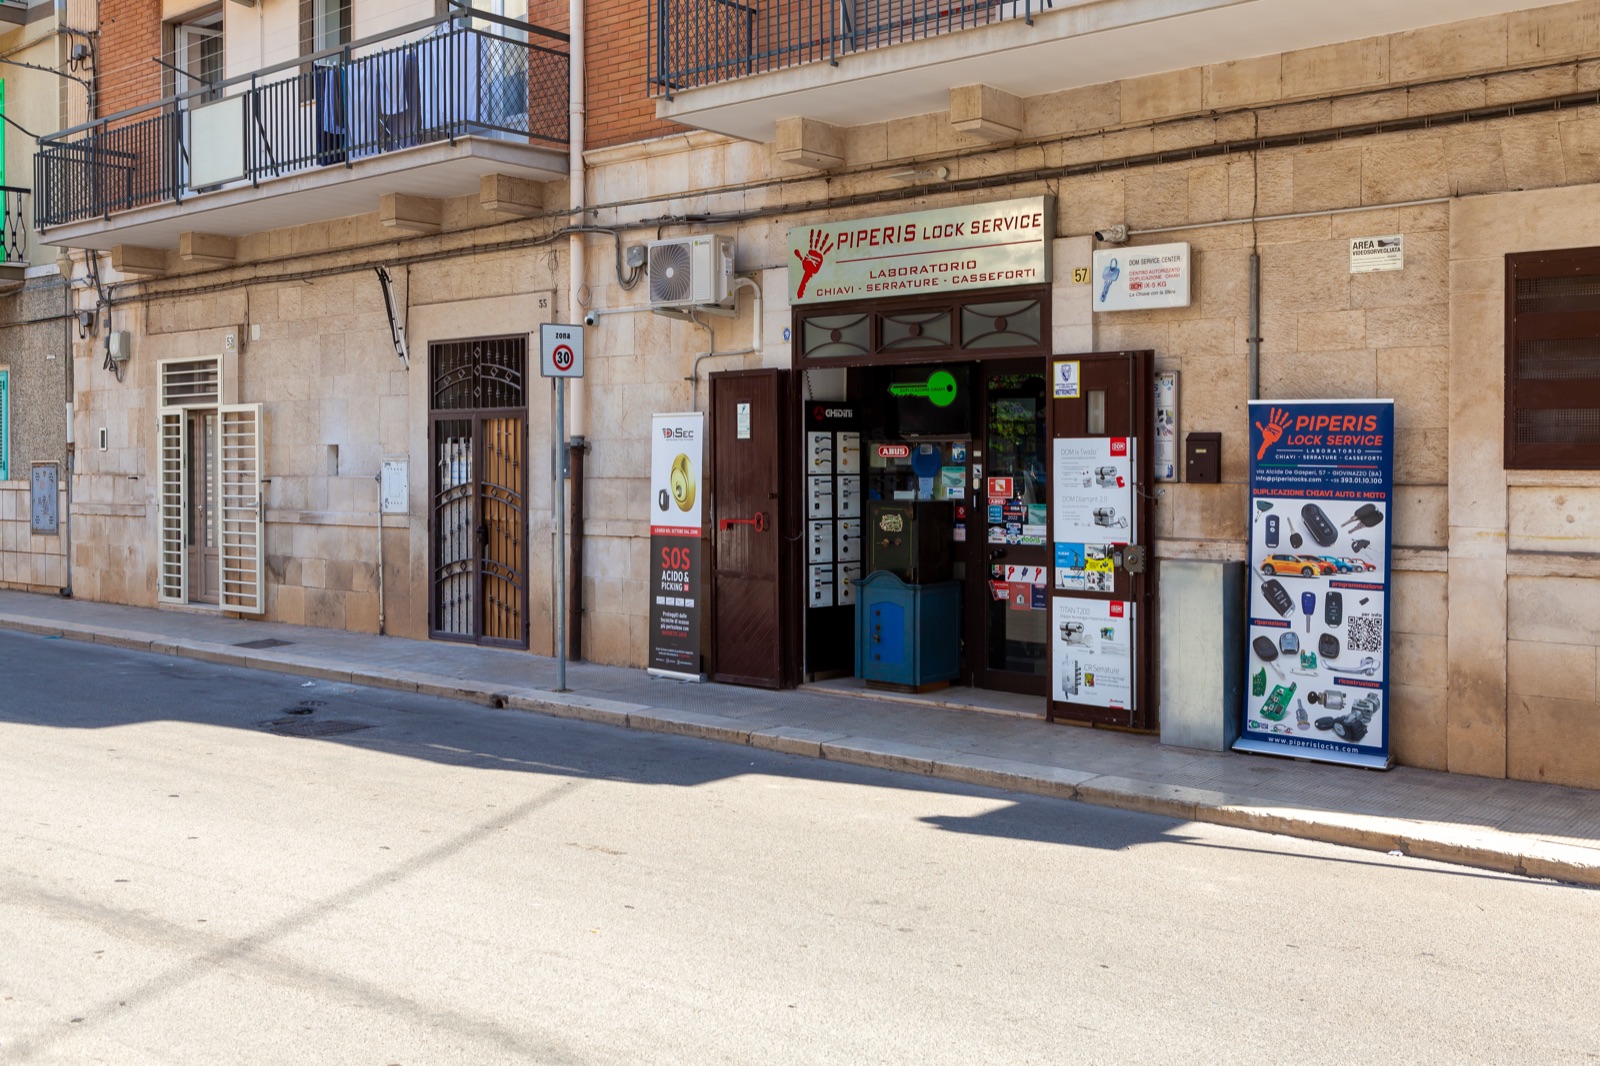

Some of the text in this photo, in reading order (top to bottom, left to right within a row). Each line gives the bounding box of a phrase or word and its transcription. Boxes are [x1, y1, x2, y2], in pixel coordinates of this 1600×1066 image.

[837, 213, 1043, 250] PIPERIS LOCK SERVICE
[1352, 240, 1375, 250] AREA
[1352, 247, 1401, 256] VIDEOSORVEGLIATA
[1141, 257, 1160, 265] SERVICE
[1161, 255, 1181, 263] CENTER
[870, 260, 977, 280] LABORATORIO
[1075, 268, 1088, 282] 57
[816, 286, 855, 297] CHIAVI
[866, 277, 939, 292] SERRATURE
[952, 268, 1036, 284] CASSEFORTI
[555, 332, 571, 340] zona
[557, 351, 570, 364] 30
[1295, 415, 1378, 432] PIPERIS
[1287, 435, 1384, 447] LOCK SERVICE
[1255, 475, 1322, 483] info@piperislocks.com
[1253, 488, 1304, 496] DUPLICAZIONE
[1305, 489, 1334, 497] CHIAVI
[1363, 491, 1386, 499] MOTO
[661, 546, 691, 570] SOS
[661, 570, 689, 583] ACIDO &
[661, 581, 683, 592] PICKING
[1331, 581, 1384, 590] programmazione
[1254, 619, 1288, 628] riparazione
[1338, 678, 1380, 688] ricostruzione
[1267, 736, 1359, 754] www.piperislocks.com
